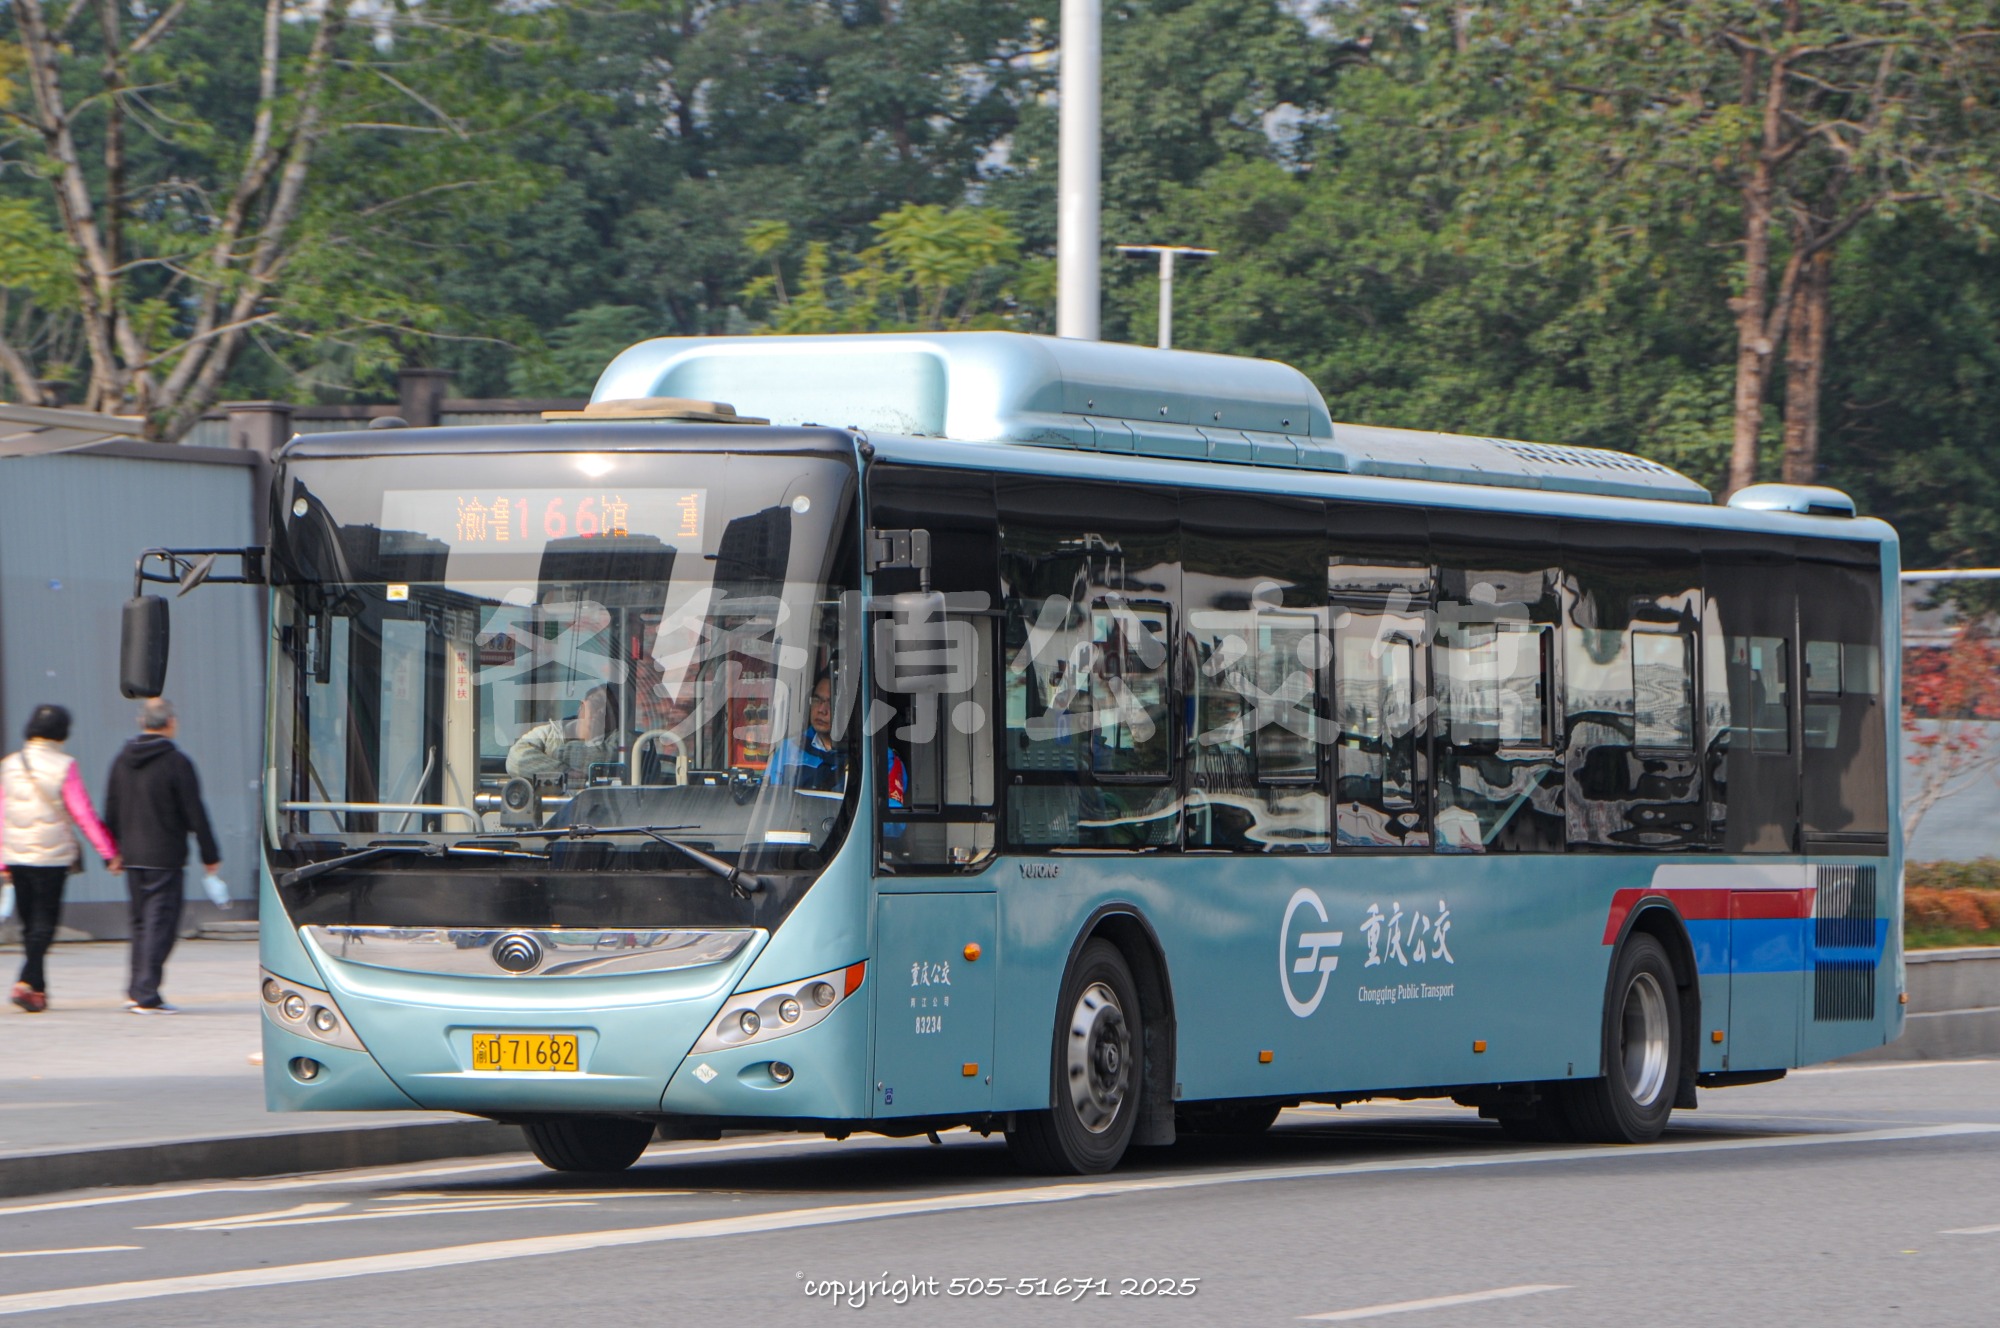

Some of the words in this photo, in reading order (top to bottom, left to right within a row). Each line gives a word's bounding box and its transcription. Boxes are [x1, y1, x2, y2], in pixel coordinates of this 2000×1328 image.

[515, 497, 598, 538] 166
[456, 652, 468, 699] 禁止手扶
[1019, 863, 1059, 879] YUTONG
[1359, 899, 1454, 968] 重庆公交
[911, 961, 951, 987] 重庆公交
[1358, 984, 1396, 1005] Chongqing
[1398, 983, 1419, 999] Public
[1421, 983, 1454, 1001] Transport
[915, 1015, 941, 1034] 83234
